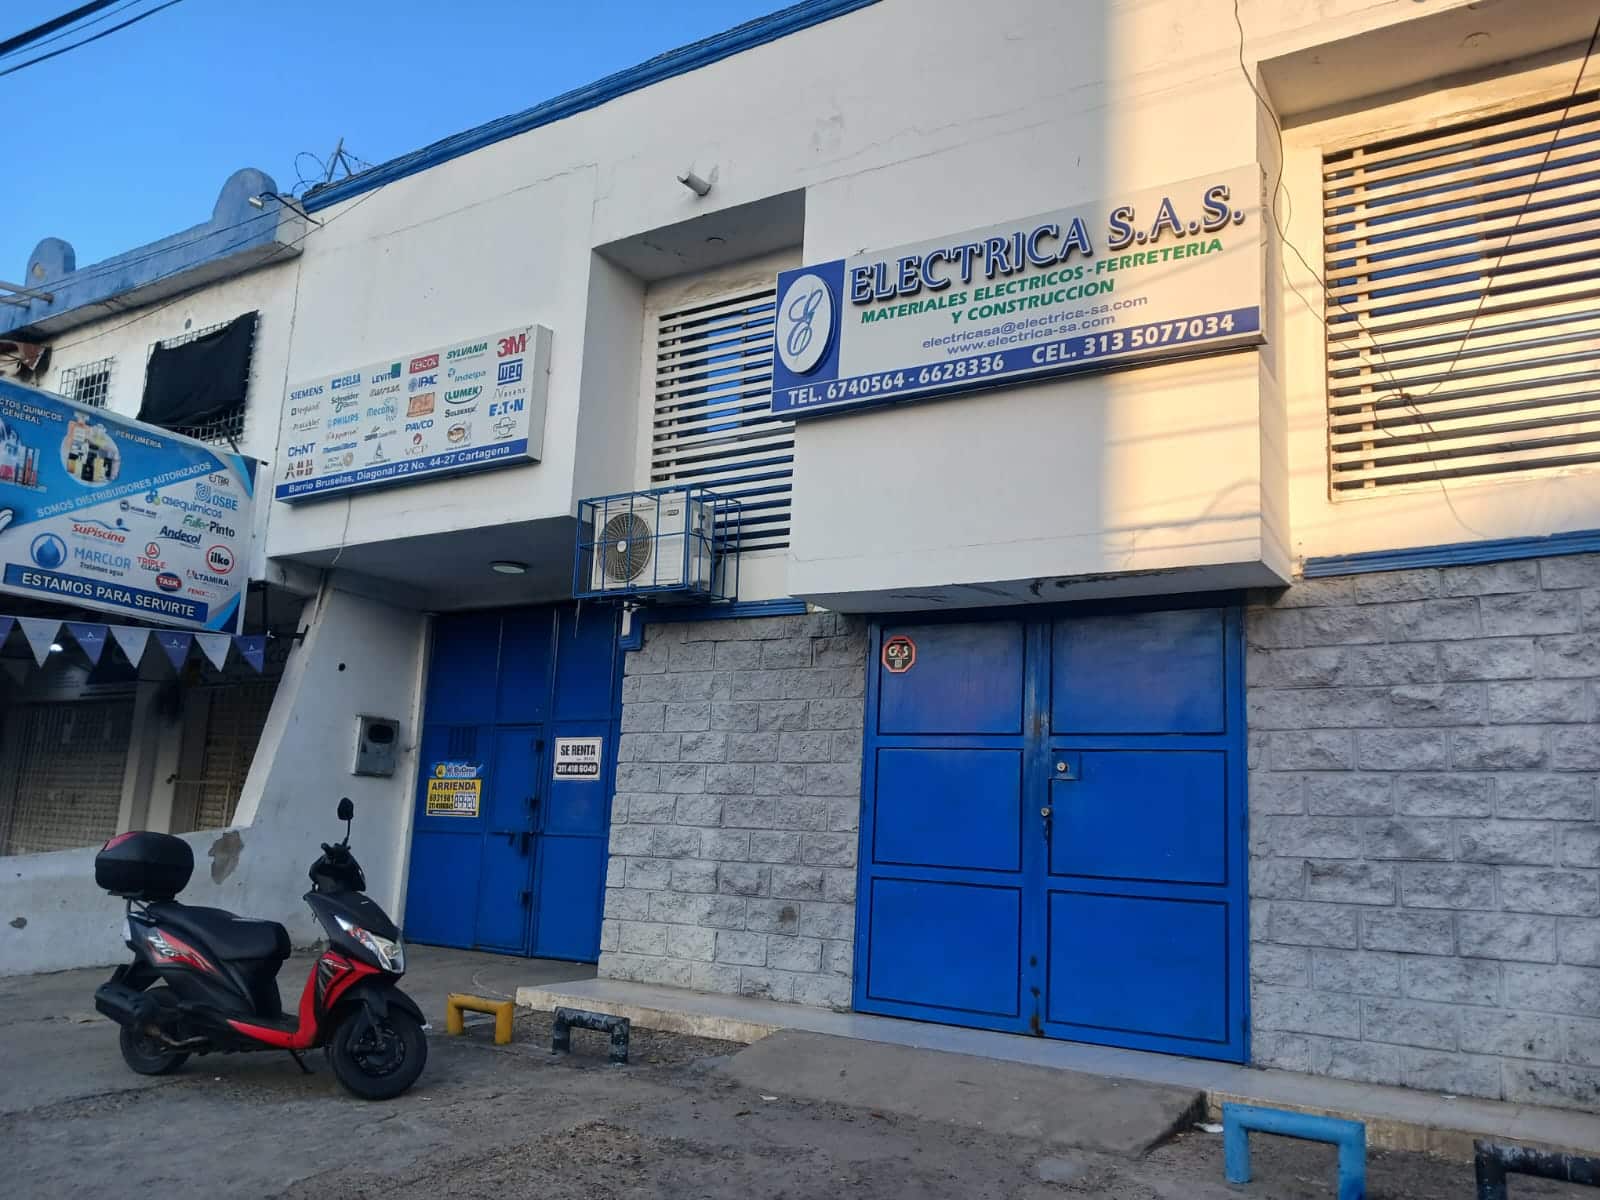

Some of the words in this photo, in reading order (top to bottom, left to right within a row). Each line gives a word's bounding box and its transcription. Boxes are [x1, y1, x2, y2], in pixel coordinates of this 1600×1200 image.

[849, 216, 1093, 304] ELECTRICA
[1107, 185, 1244, 251] S.A.S.
[861, 292, 967, 324] MATERIALES
[974, 266, 1084, 301] ELECTRICOS
[1095, 238, 1224, 276] FERRETERIA
[952, 310, 963, 325] Y
[967, 279, 1115, 321] CONSTRUCCION
[922, 296, 1148, 349] electricasa@electrica-sa.com
[497, 333, 526, 357] 3M
[946, 316, 1116, 355] www.electrica-sa.com
[446, 342, 488, 359] SYLVANIA
[788, 389, 822, 406] TEL.
[827, 372, 904, 400] 6740564
[919, 354, 1004, 384] 6628336
[1032, 344, 1077, 365] CEL.
[1083, 332, 1124, 356] 313
[1131, 314, 1234, 348] 5077034
[289, 385, 324, 400] SIEMENS
[3, 408, 41, 425] GENERAL
[23, 404, 64, 421] QUIMICOS
[405, 420, 433, 432] PAVCO
[115, 430, 163, 448] PERFUMERIA
[289, 482, 314, 494] Barrio
[315, 474, 354, 489] Bruselas,
[357, 465, 395, 481] Diagonal
[398, 463, 408, 473] 22
[411, 460, 425, 470] No.
[430, 453, 456, 467] 44-27
[458, 445, 510, 463] Cartagena
[37, 501, 74, 518] SOMOS
[77, 478, 152, 507] DISTRIBUIDORES
[153, 462, 212, 486] AUTORIZADOS
[159, 525, 202, 545] Andecol
[74, 547, 131, 569] MARCLOR
[137, 556, 167, 569] TRIPLE
[210, 552, 230, 566] ilko
[22, 572, 93, 596] ESTAMOS
[96, 586, 132, 604] PARA
[135, 595, 195, 617] SERVIRTE
[560, 744, 570, 756] SE
[571, 744, 596, 756] RENTA
[431, 781, 477, 791] ARRIENDA
